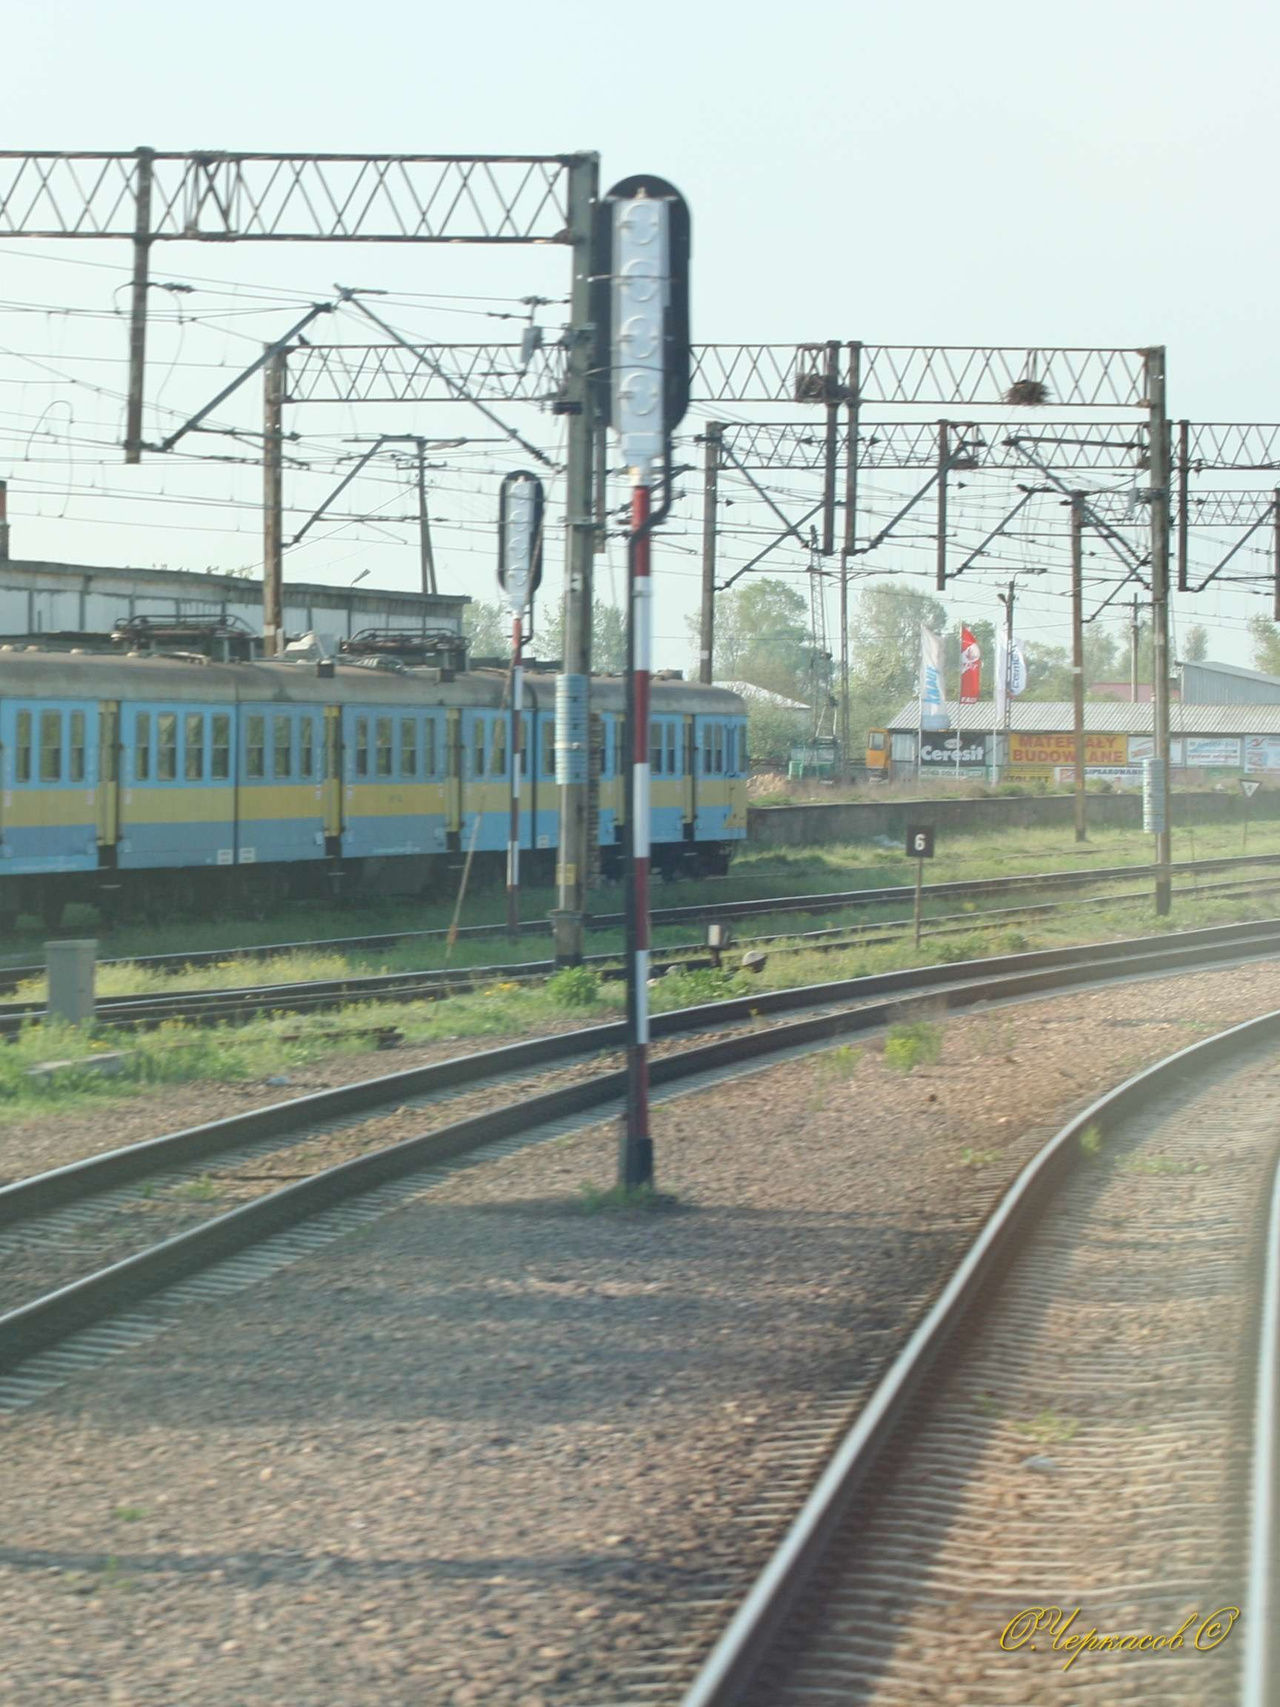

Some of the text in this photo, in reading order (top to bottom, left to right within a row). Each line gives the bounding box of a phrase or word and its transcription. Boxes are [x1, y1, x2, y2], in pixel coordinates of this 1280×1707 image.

[1019, 733, 1117, 748] MATERAŁY
[921, 744, 984, 761] Ceresit
[1013, 748, 1124, 762] BUDOWANE
[914, 833, 926, 851] 6
